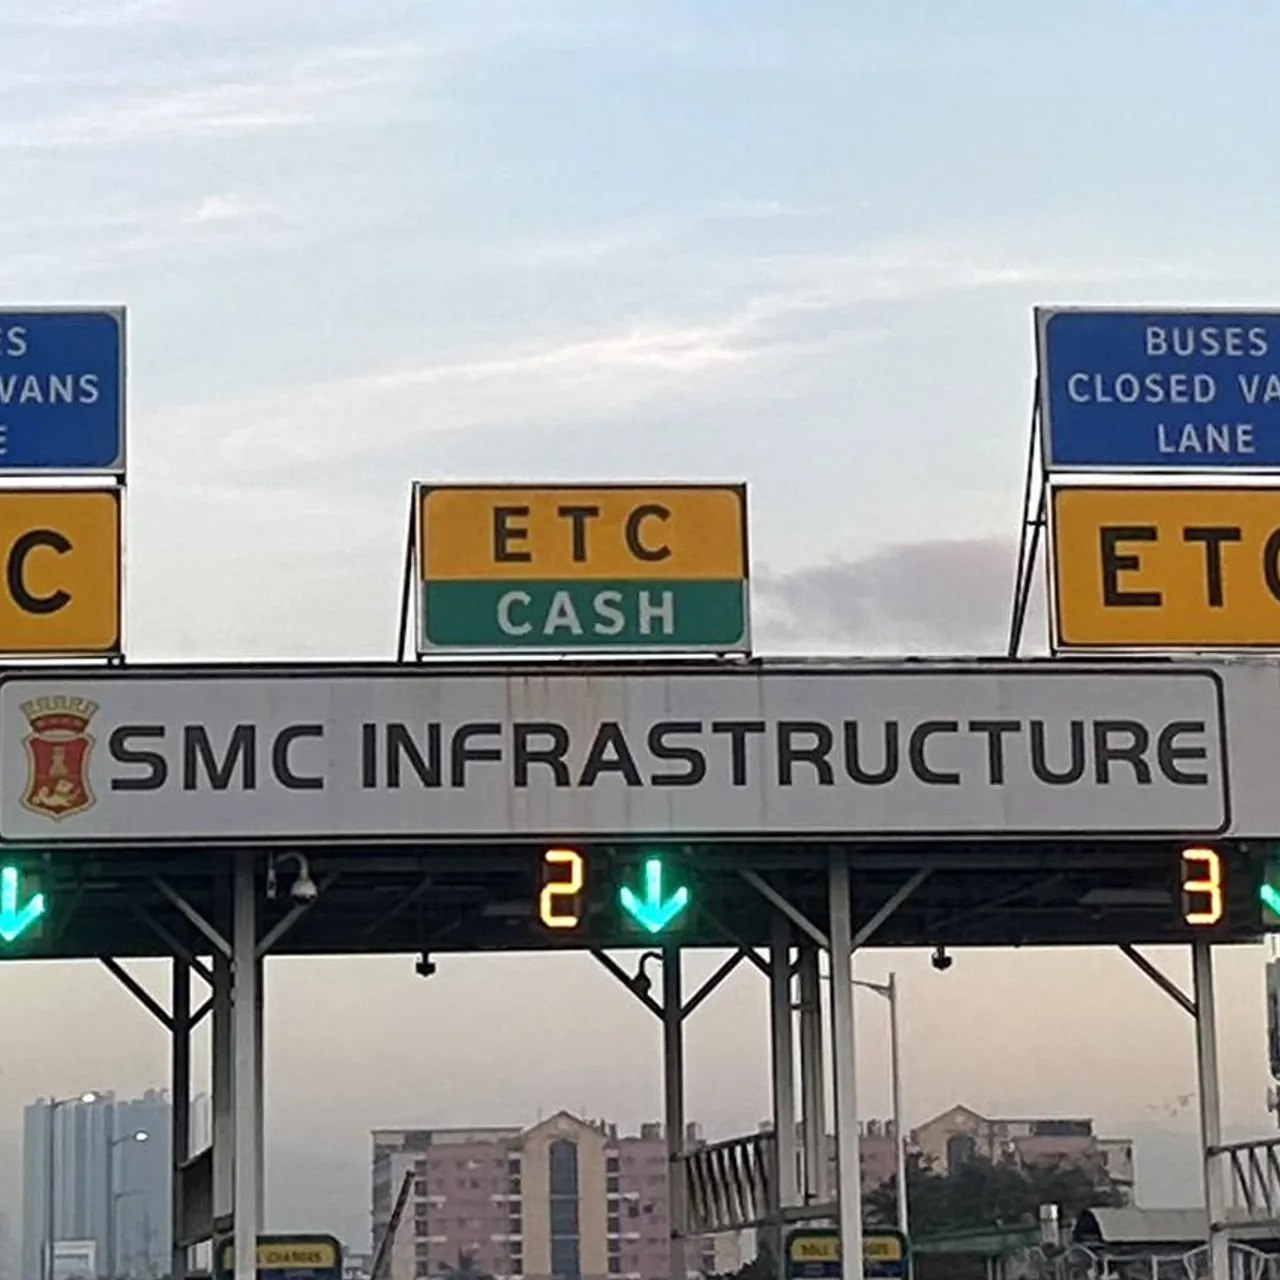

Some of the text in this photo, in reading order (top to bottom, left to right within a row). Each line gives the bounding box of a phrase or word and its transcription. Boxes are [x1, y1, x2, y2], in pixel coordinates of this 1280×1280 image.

[1146, 327, 1268, 356] BUSES
[1067, 373, 1216, 403] CLOSED
[1157, 424, 1255, 454] LANE
[492, 504, 673, 563] ETC
[496, 590, 674, 635] CASH
[109, 718, 1210, 792] SMC INFRASTRUCTURE
[540, 849, 583, 928] 2
[1181, 848, 1223, 925] 3
